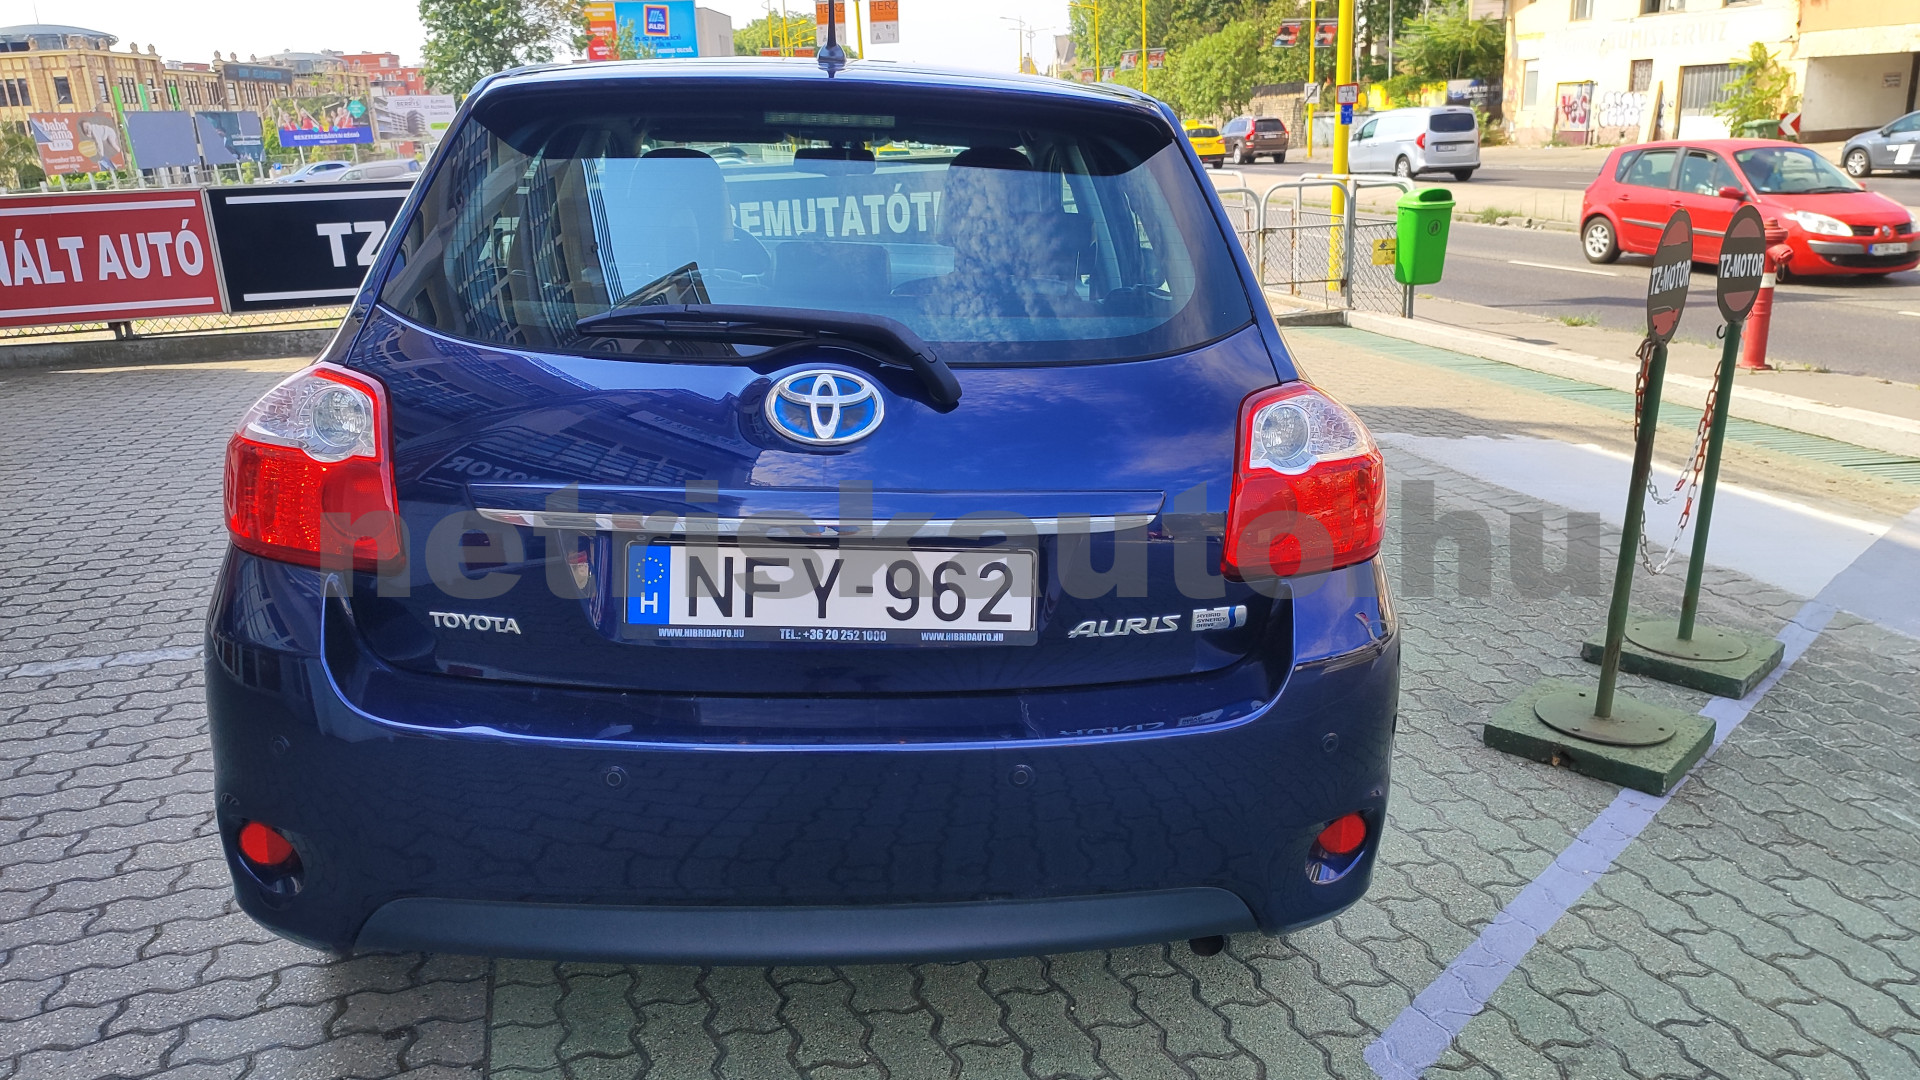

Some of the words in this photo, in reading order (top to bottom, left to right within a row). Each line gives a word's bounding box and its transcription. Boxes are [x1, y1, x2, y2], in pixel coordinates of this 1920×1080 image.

[98, 219, 204, 281] AUTÓ
[1650, 260, 1692, 296] TZ-MOTOR
[1720, 253, 1765, 279] TZ-MOTOR
[688, 555, 1014, 623] NFY-962
[640, 592, 659, 614] H
[429, 611, 522, 635] TOYOTA
[658, 628, 745, 639] WWW.HIBRIDAUTO.HU
[779, 629, 801, 640] TEL.:
[802, 629, 824, 641] +36
[825, 630, 839, 641] 20
[841, 630, 860, 641] 252
[1067, 614, 1182, 639] AURIS
[920, 632, 1004, 642] WWW.HIBRIDAUTO.HU
